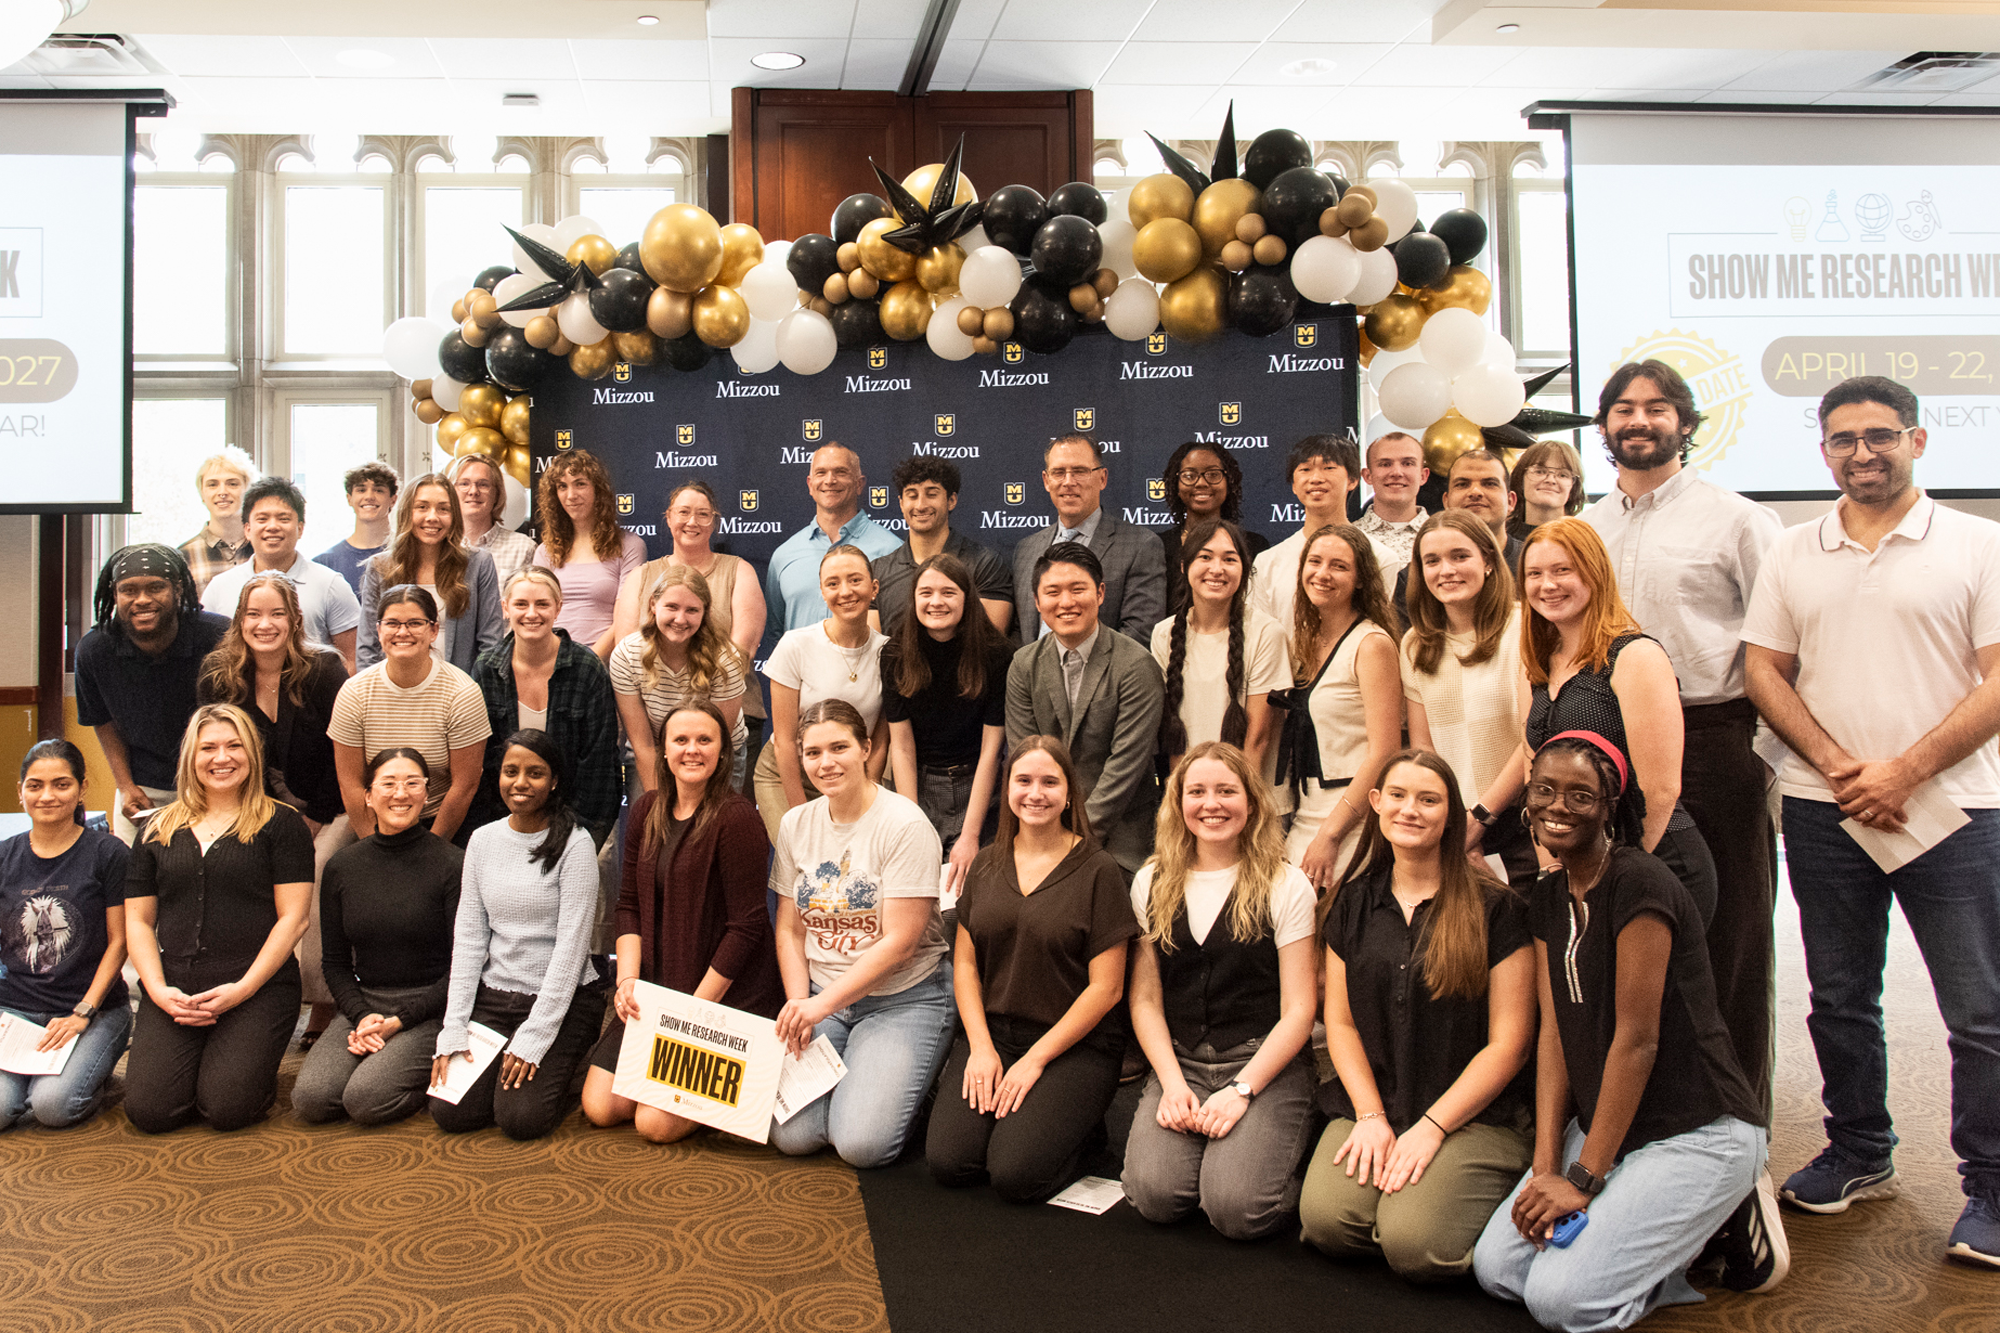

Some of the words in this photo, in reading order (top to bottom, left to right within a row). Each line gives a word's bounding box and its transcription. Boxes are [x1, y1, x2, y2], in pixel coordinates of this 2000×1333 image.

[1689, 254, 1769, 299] SHOW
[1776, 254, 1815, 299] ME
[1820, 253, 1963, 299] RESEARCH
[1120, 361, 1194, 380] Mizzou
[1267, 354, 1345, 373] Mizzou
[1885, 351, 1919, 380] 19
[1948, 351, 1994, 384] 22,
[844, 376, 912, 393] Mizzou
[978, 370, 1050, 388] Mizzou
[1696, 363, 1751, 405] DATE
[593, 388, 655, 405] Mizzou
[716, 381, 781, 399] Mizzou
[1924, 406, 1991, 427] NEXT
[780, 446, 814, 464] Miz
[912, 442, 980, 458] Mizzou
[655, 451, 718, 469] Mizzou
[718, 517, 782, 534] Mizzou
[980, 511, 1050, 529] Mizzou
[801, 907, 878, 935] Kansas
[660, 1013, 682, 1032] SHOW
[680, 1020, 692, 1036] ME
[691, 1023, 729, 1047] RESEARCH
[728, 1034, 749, 1053] WEEK
[651, 1037, 742, 1105] WINNER
